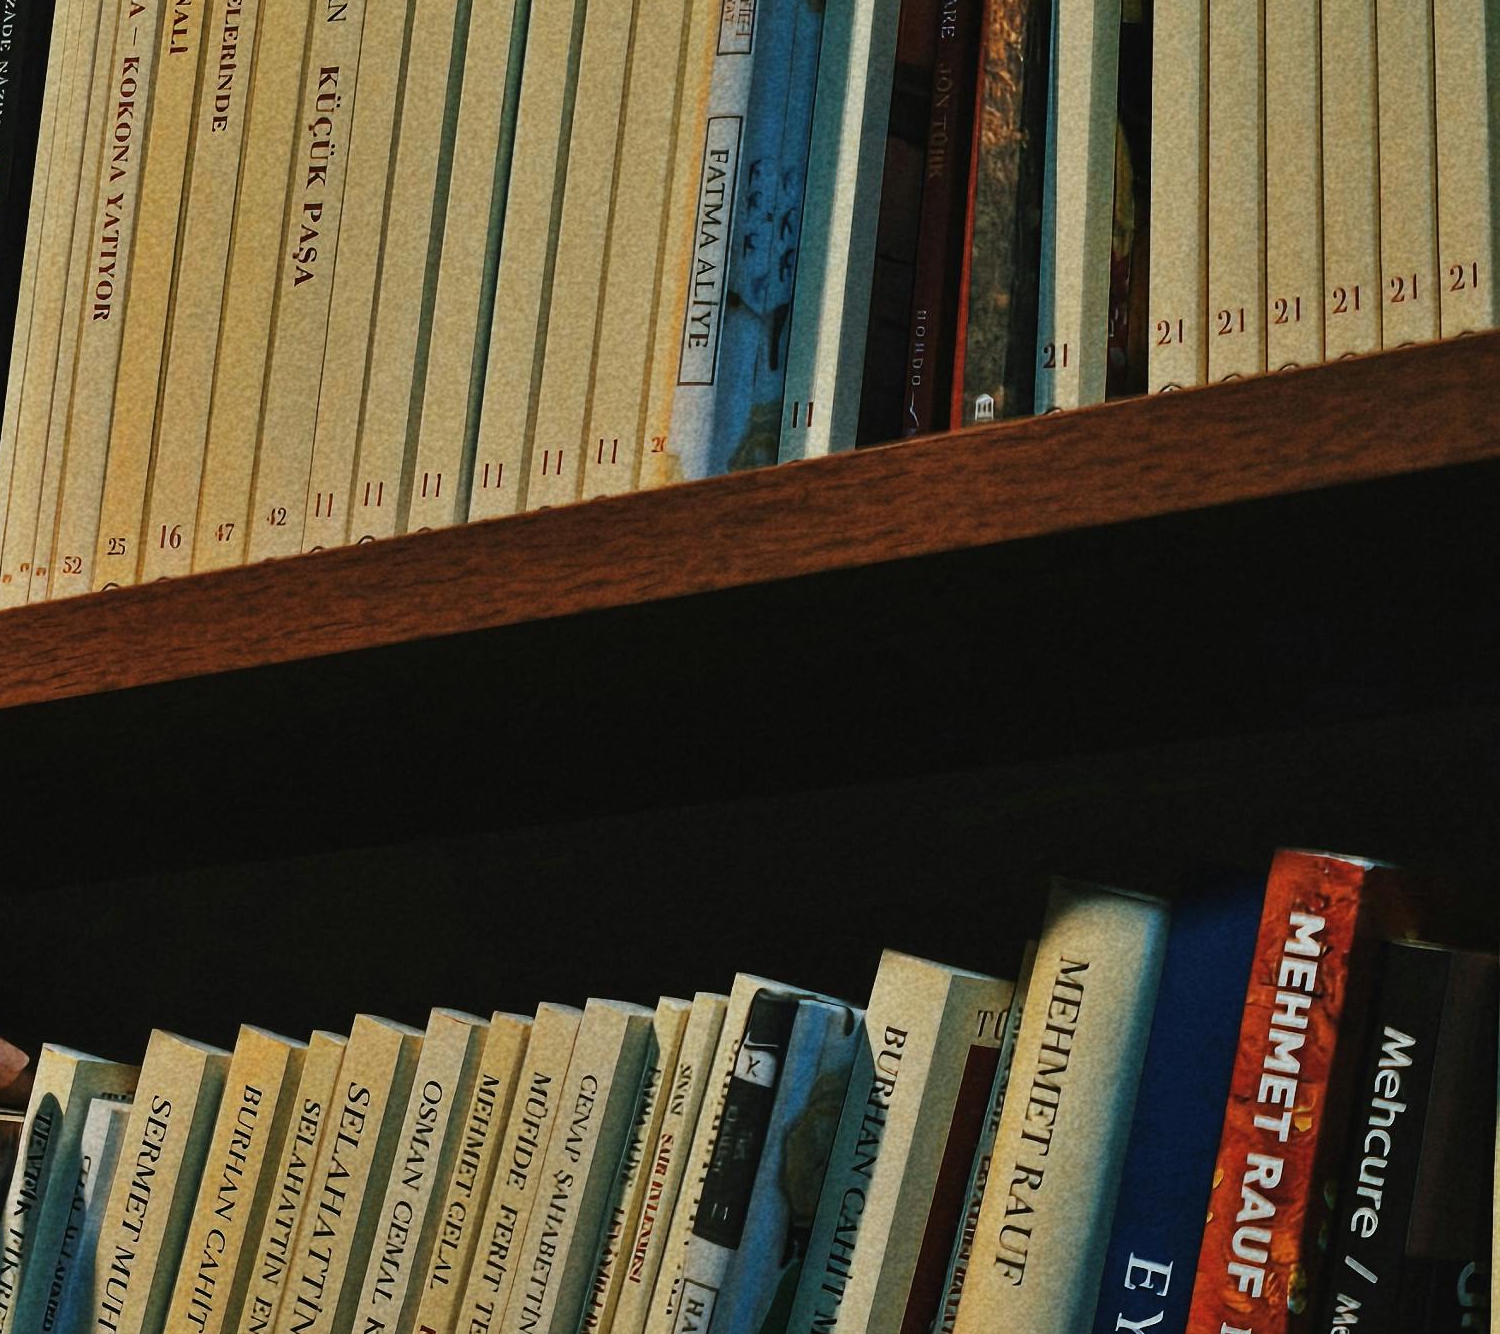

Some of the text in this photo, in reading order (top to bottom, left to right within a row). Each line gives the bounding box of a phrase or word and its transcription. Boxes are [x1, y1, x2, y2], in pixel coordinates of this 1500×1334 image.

[110, 56, 141, 179] KOKONA
[304, 65, 340, 189] KÜÇÜK
[293, 201, 323, 287] PAŞA
[699, 148, 730, 248] FATMA
[93, 192, 124, 321] YATIYOR
[689, 259, 718, 349] ALİYE
[1390, 274, 1417, 302] 21
[1217, 308, 1244, 336] 21
[160, 524, 182, 548] 16
[315, 493, 334, 517] 11
[1020, 956, 1089, 1156] MEHMET
[1254, 912, 1324, 1143] MEHMET
[121, 1096, 172, 1242] SERMET
[215, 1085, 262, 1220] BURHAN
[401, 1080, 443, 1190] OSMAN
[455, 1074, 499, 1198] MEHMET
[506, 1071, 551, 1190] MÜFİDE
[1349, 1026, 1417, 1238] Mehcure
[187, 1229, 227, 1332] CAHİT
[371, 1199, 413, 1304] CEMAL
[431, 1202, 466, 1289] CELAL
[482, 1204, 518, 1292] FERİT
[992, 1162, 1044, 1288] RAUF
[1228, 1153, 1285, 1298] RAUF
